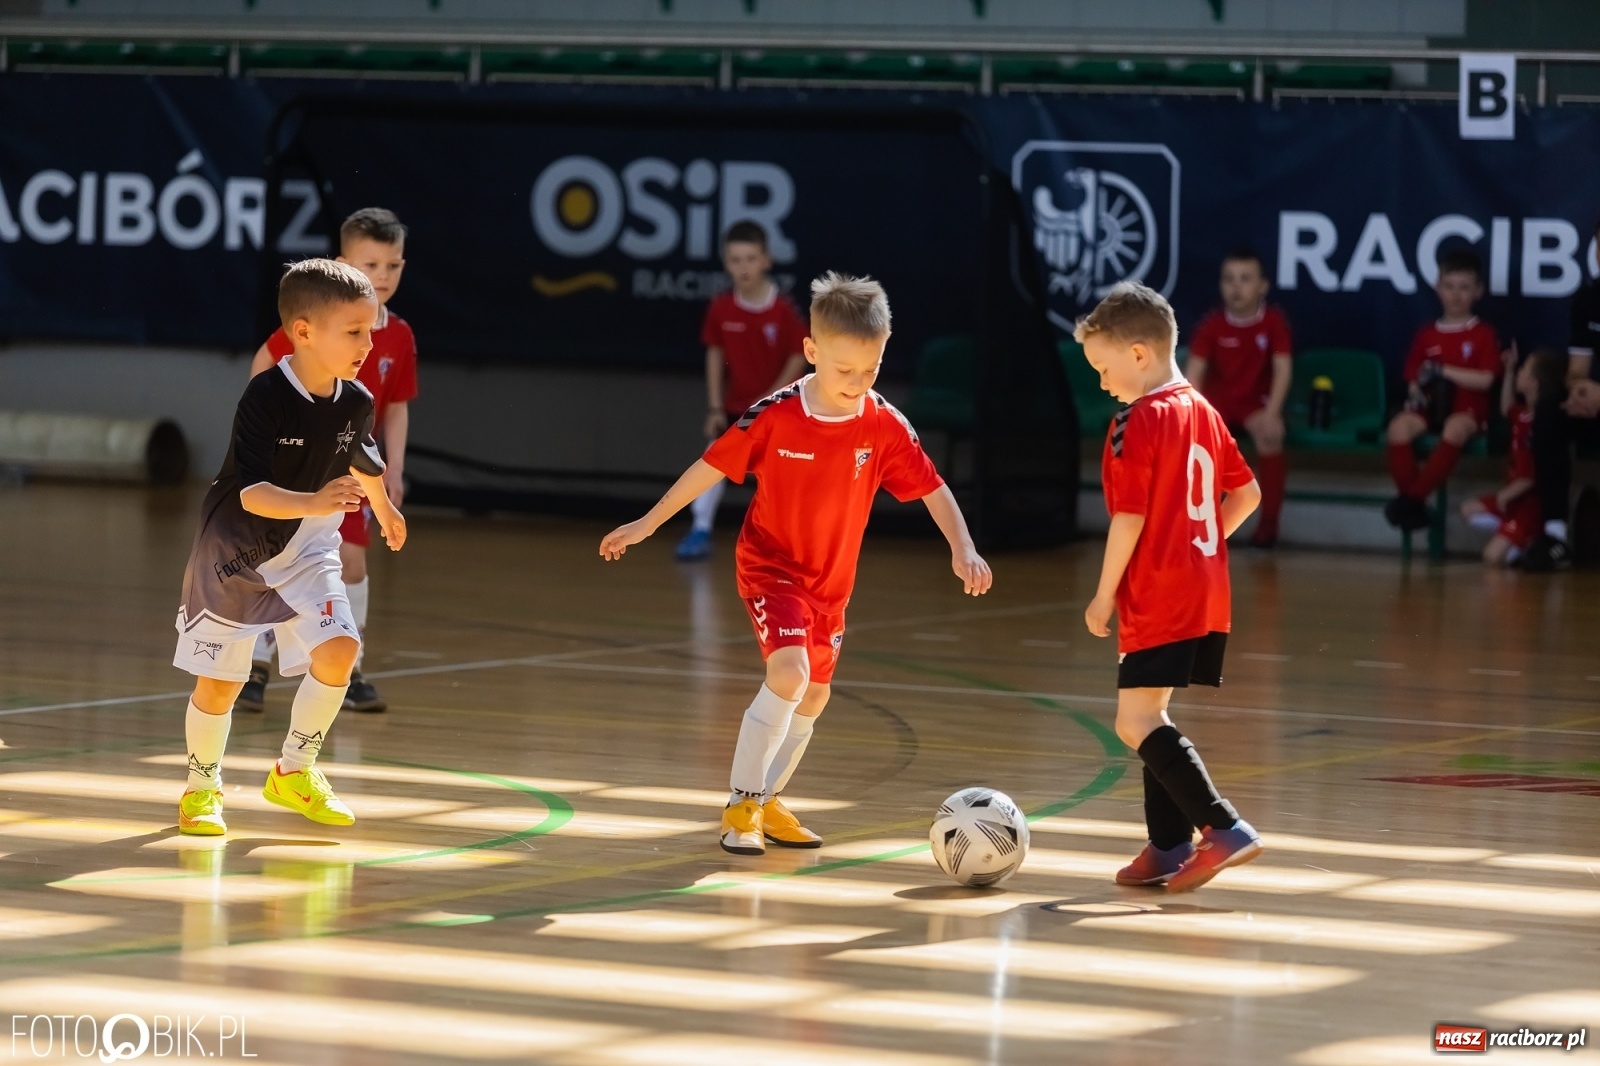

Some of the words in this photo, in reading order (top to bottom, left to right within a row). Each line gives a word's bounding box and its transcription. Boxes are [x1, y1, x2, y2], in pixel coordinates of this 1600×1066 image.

[1467, 71, 1508, 119] B
[1277, 210, 1600, 297] RACIB
[1186, 443, 1219, 557] 9
